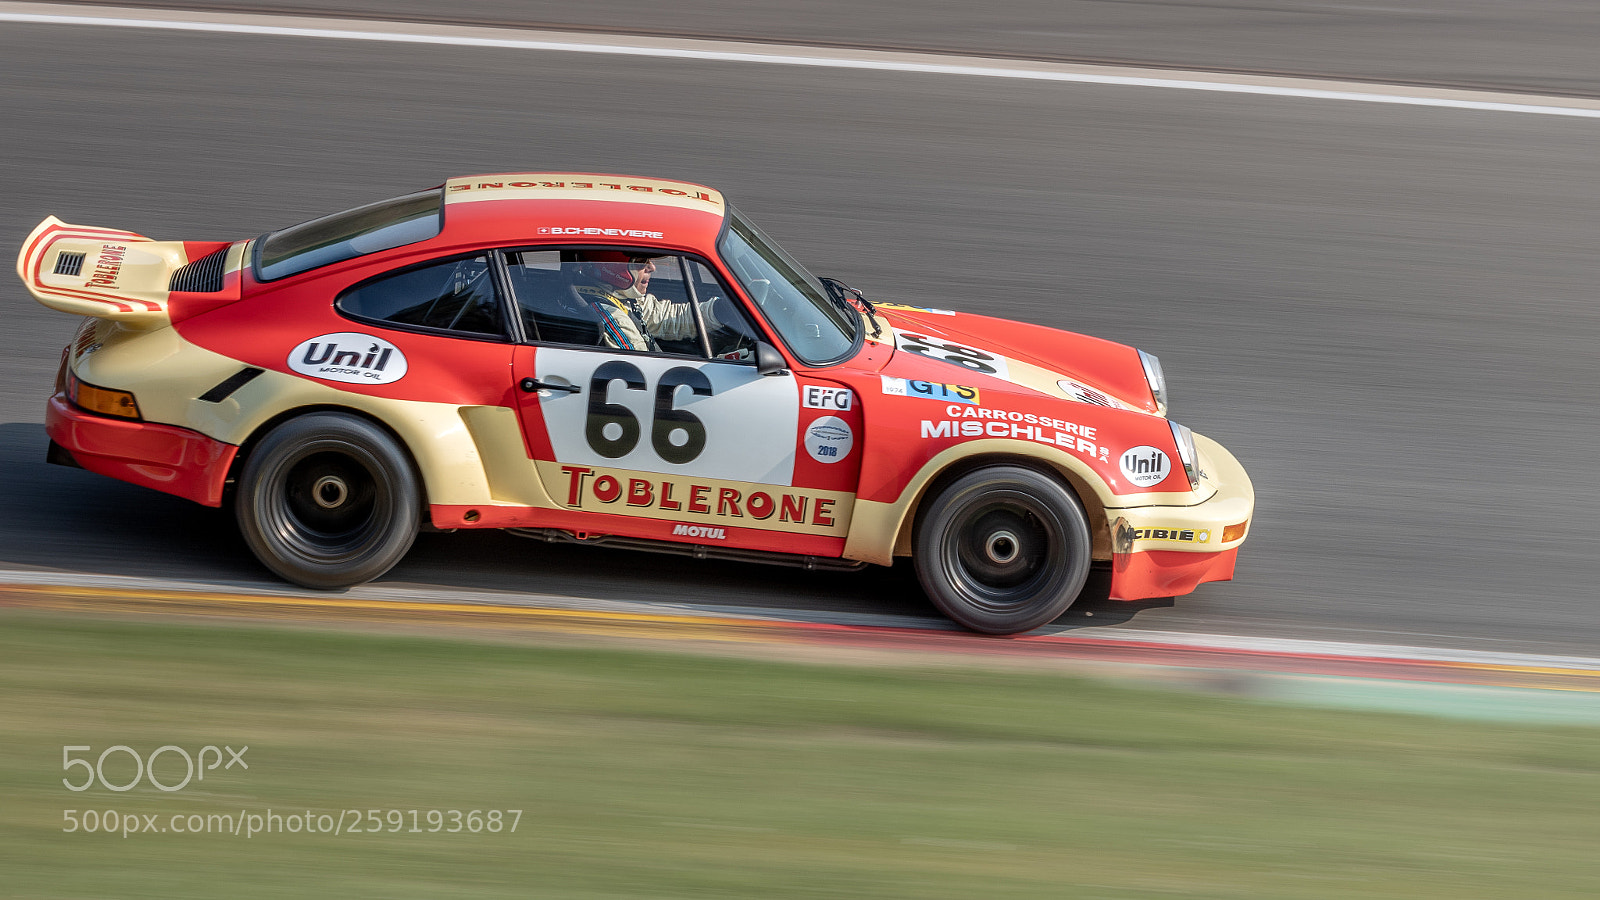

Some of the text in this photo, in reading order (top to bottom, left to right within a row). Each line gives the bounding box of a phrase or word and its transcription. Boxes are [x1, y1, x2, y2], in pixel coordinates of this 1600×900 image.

[450, 181, 720, 204] TOBLERONE
[551, 227, 664, 239] B.CHENEVIERE
[84, 244, 127, 289] TOBLERONE
[303, 343, 393, 371] Unil
[900, 333, 997, 374] 66
[320, 367, 381, 380] MOTOR OIL
[809, 388, 848, 408] EFG
[586, 360, 714, 464] 66
[946, 405, 1097, 440] CARROSSERIE
[818, 445, 838, 457] 2018
[920, 420, 1097, 457] MISCHLER
[1125, 451, 1163, 473] Unil
[561, 466, 836, 526] TOBLERONE
[673, 524, 726, 540] MOTUL
